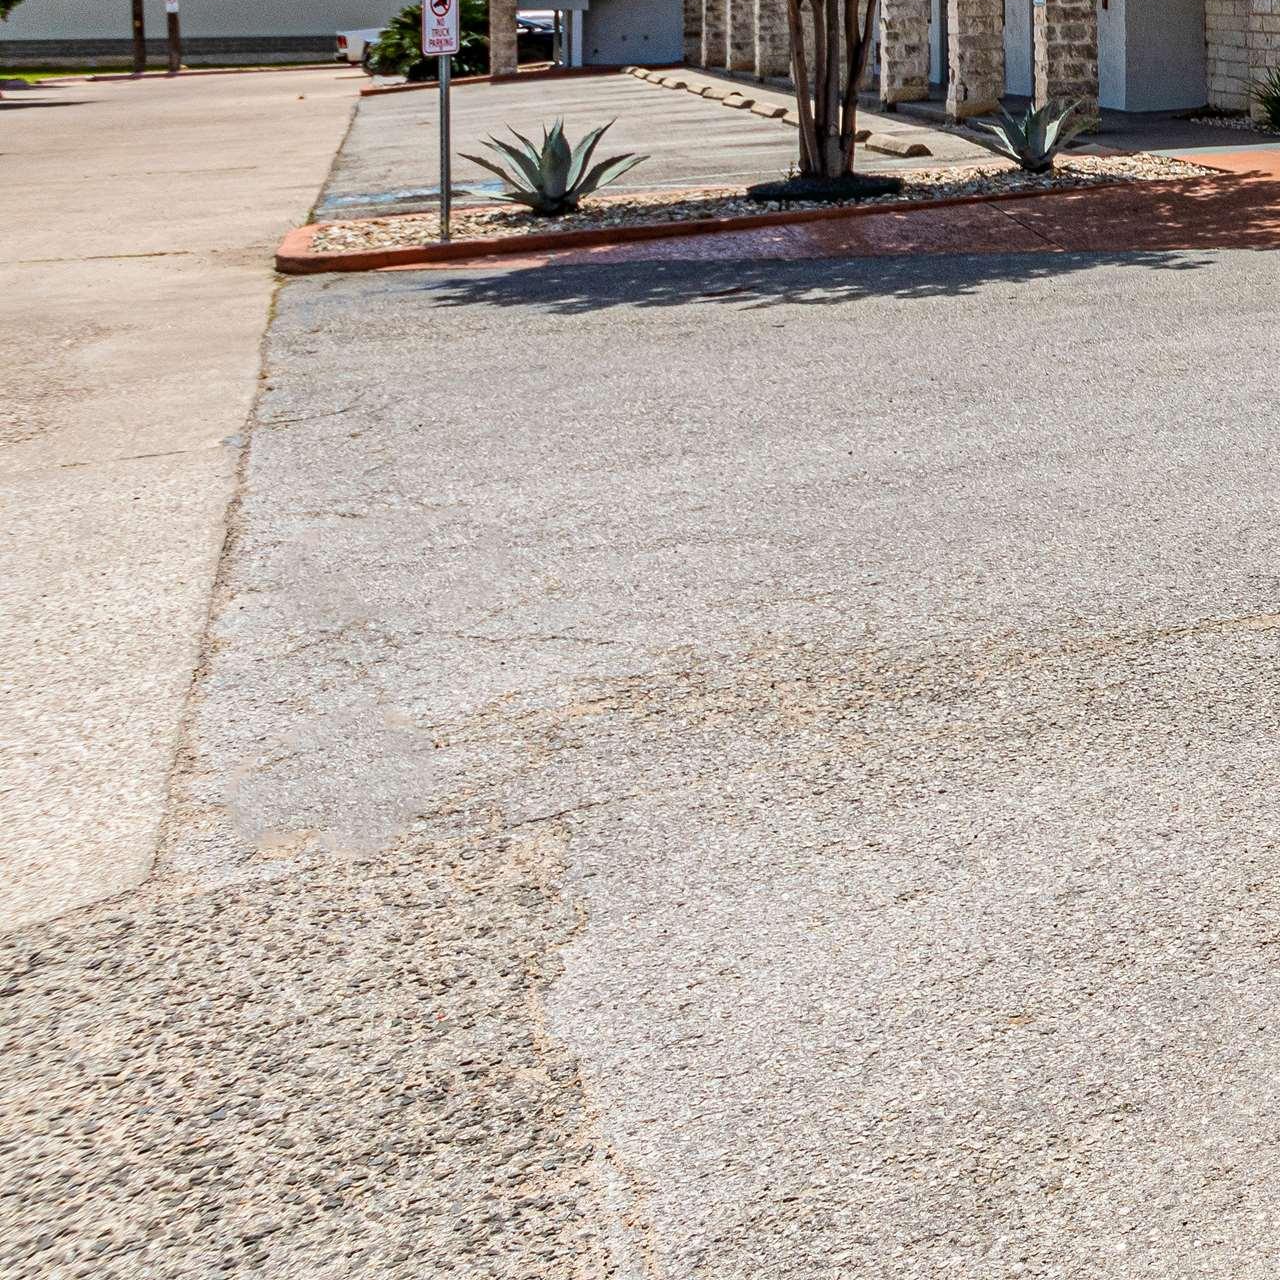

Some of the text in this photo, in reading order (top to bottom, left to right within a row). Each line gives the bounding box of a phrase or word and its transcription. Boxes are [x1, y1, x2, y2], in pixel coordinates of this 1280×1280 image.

[436, 18, 446, 27] NO
[432, 28, 450, 37] TRUCK
[429, 38, 454, 48] PARKING
